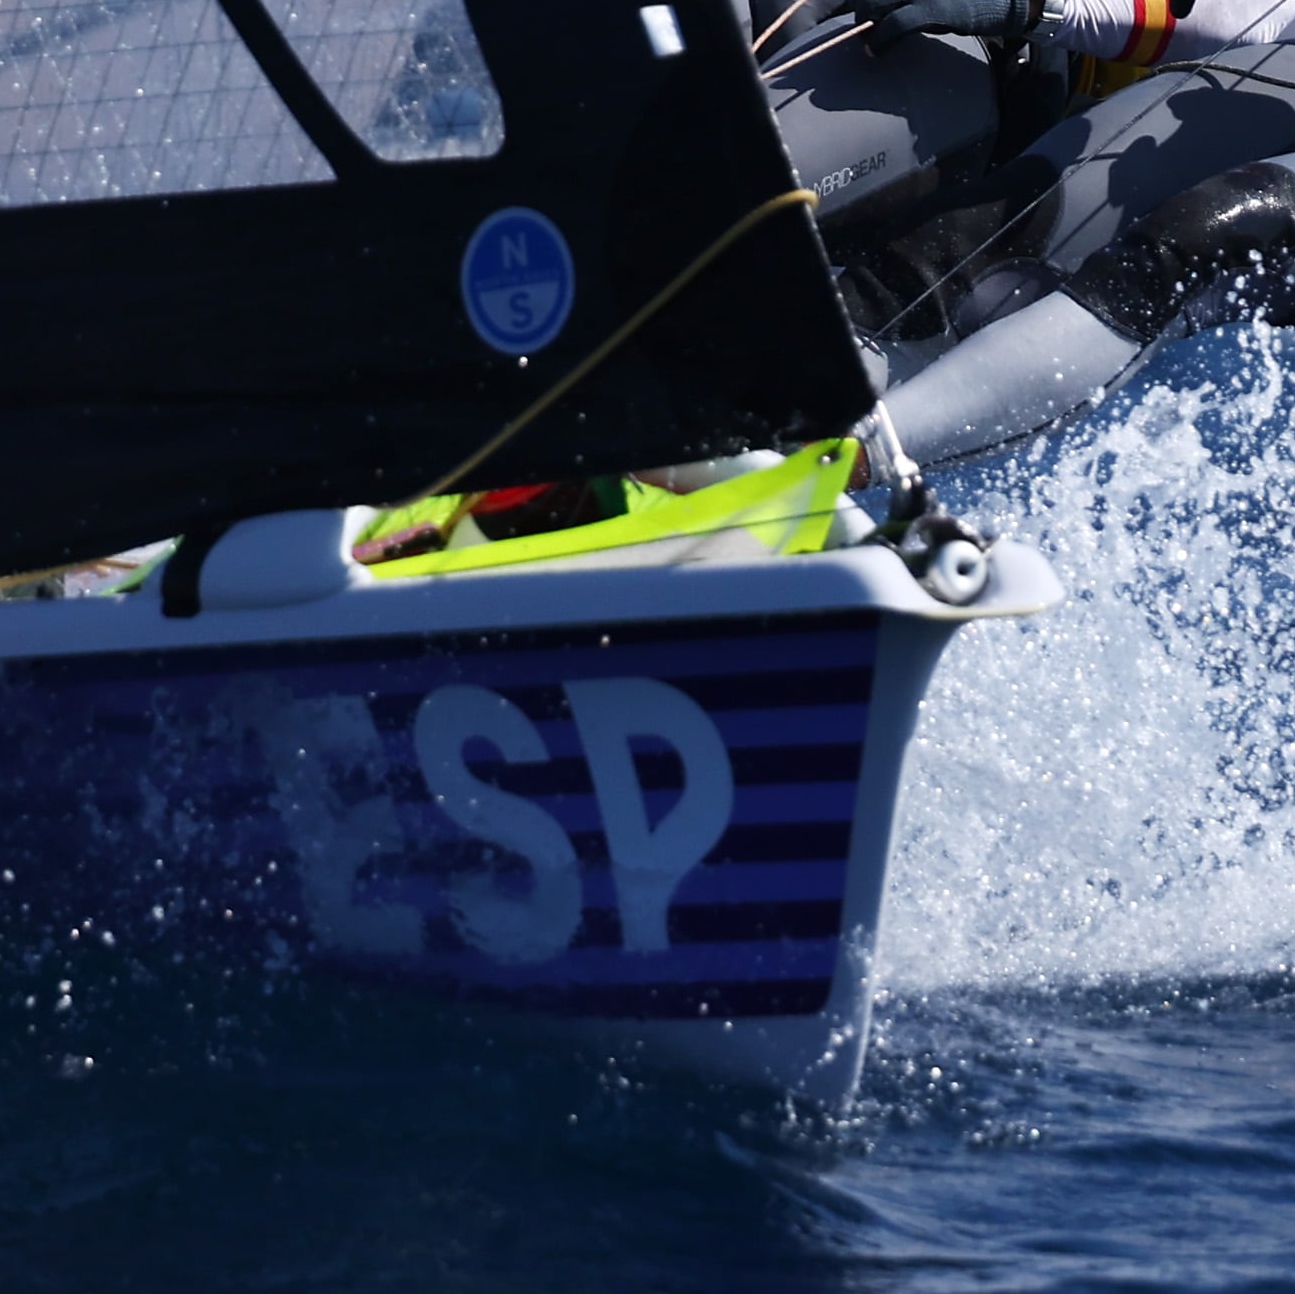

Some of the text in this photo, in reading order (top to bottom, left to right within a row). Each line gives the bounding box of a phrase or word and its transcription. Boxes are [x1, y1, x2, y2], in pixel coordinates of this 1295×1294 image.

[501, 231, 529, 271] N
[509, 292, 533, 329] S
[268, 676, 735, 967] ESP
